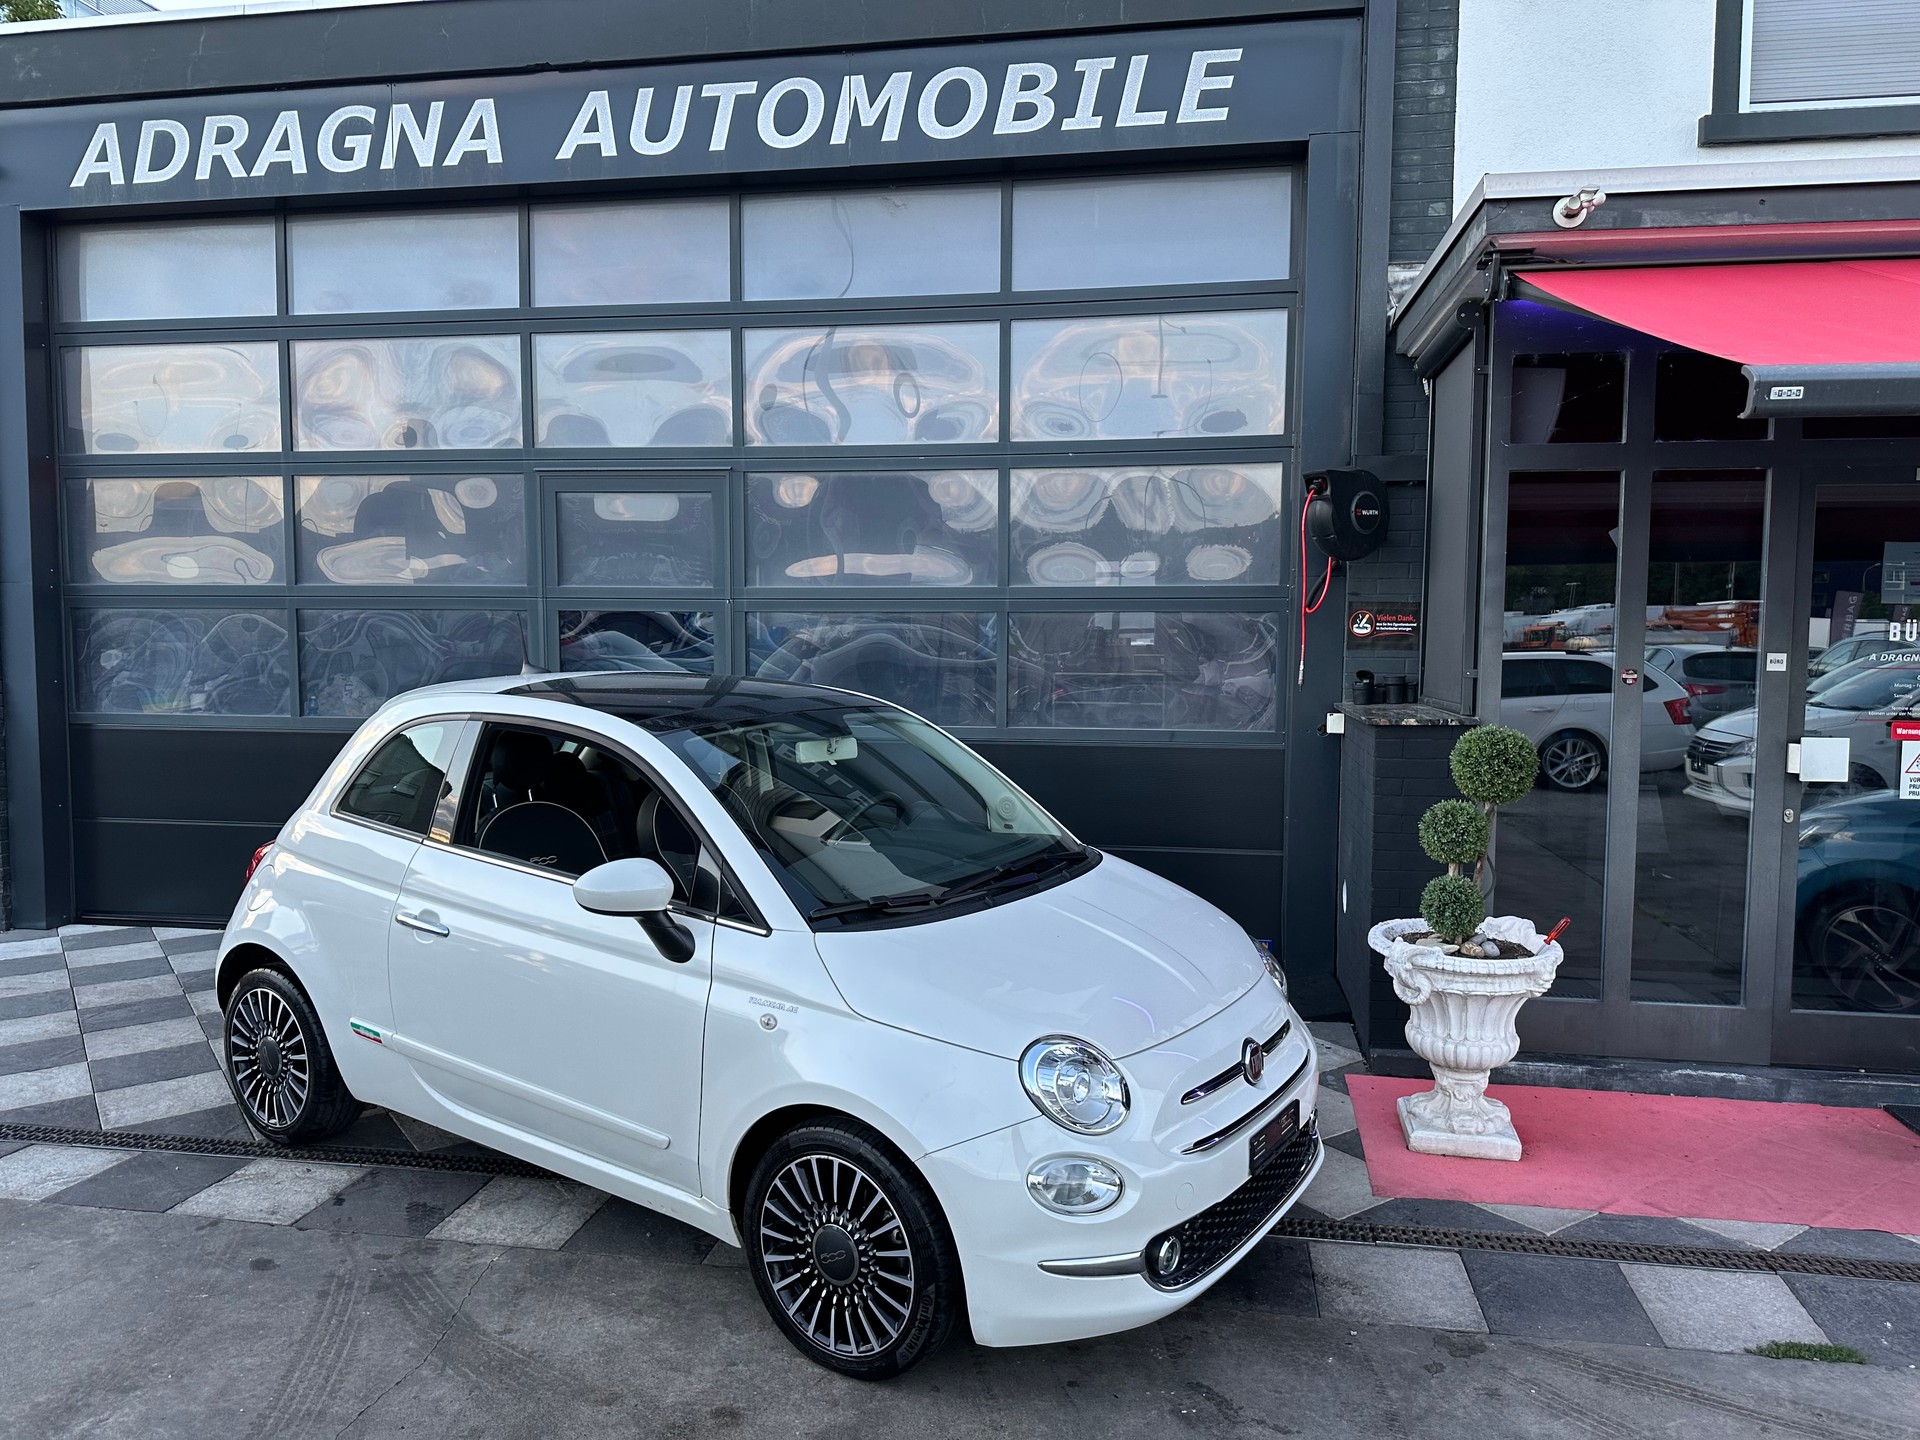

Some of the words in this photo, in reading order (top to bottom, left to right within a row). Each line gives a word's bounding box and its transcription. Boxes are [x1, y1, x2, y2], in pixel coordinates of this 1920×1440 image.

[69, 98, 503, 188] ADRAGNA
[555, 47, 1243, 160] AUTOMOBILE
[1376, 614, 1397, 622] Vielen
[820, 1249, 847, 1264] 500
